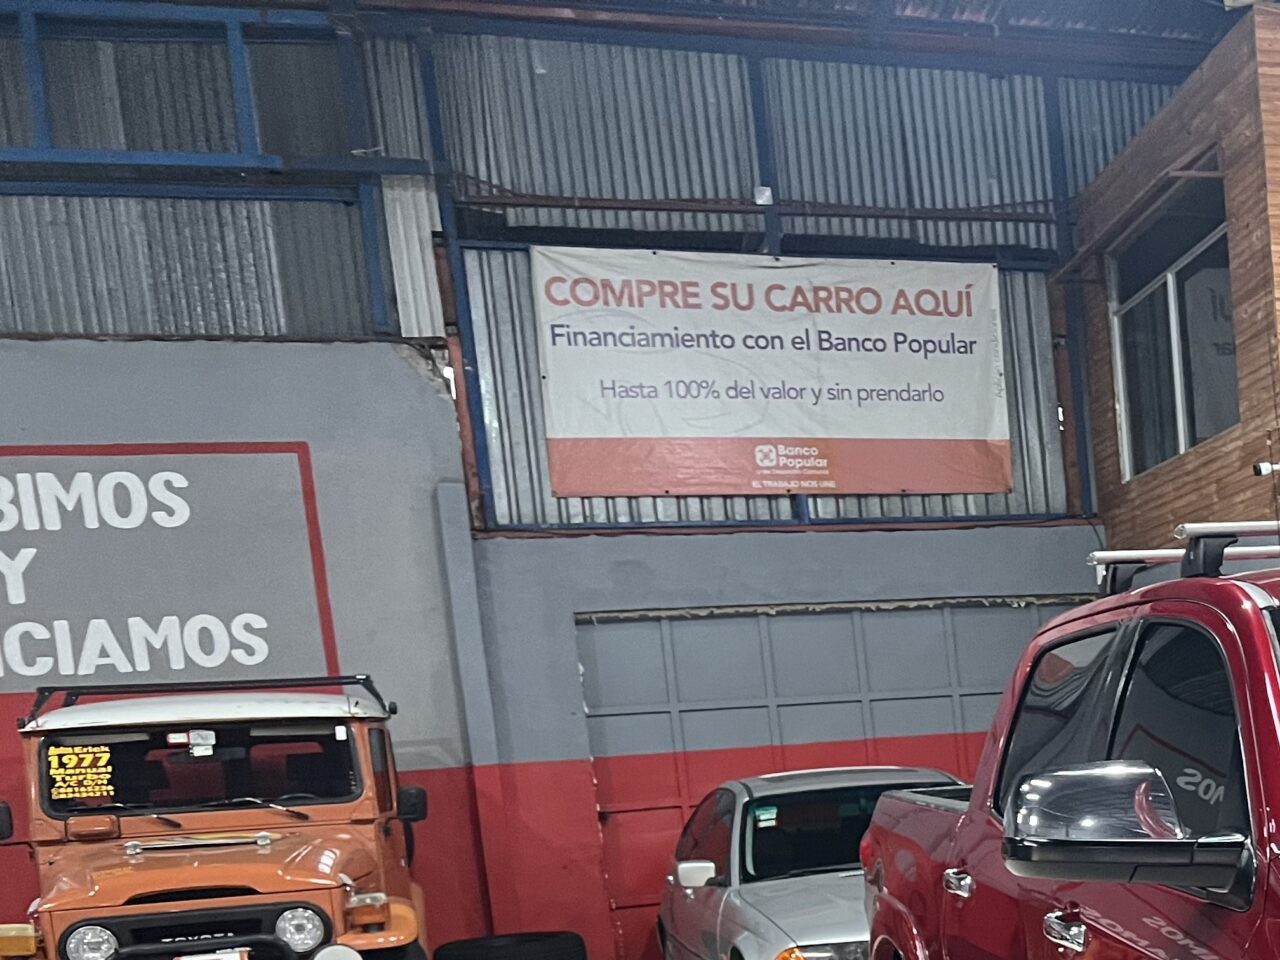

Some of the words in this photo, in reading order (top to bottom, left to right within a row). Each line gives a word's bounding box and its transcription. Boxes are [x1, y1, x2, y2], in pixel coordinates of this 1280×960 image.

[544, 275, 702, 311] COMPRE
[709, 281, 755, 312] SU
[764, 283, 882, 315] CARRO
[890, 283, 975, 317] AQUÍ
[550, 324, 735, 351] Financiamiento
[742, 332, 784, 351] con
[790, 328, 811, 351] el
[818, 330, 886, 354] Banco
[894, 333, 976, 360] Popular
[600, 379, 658, 400] Hasta
[663, 380, 720, 400] 100%
[725, 380, 756, 401] del
[760, 381, 806, 402] valor
[810, 386, 824, 407] y
[828, 382, 852, 402] sin
[857, 381, 945, 407] prendarlo
[777, 444, 819, 456] Banco
[779, 457, 828, 469] Popular
[763, 480, 799, 488] TRABAJO
[800, 480, 818, 488] NOS
[0, 548, 37, 605] Y
[0, 613, 269, 677] CIAMOS
[48, 753, 111, 768] 1977
[49, 766, 112, 775] Manual
